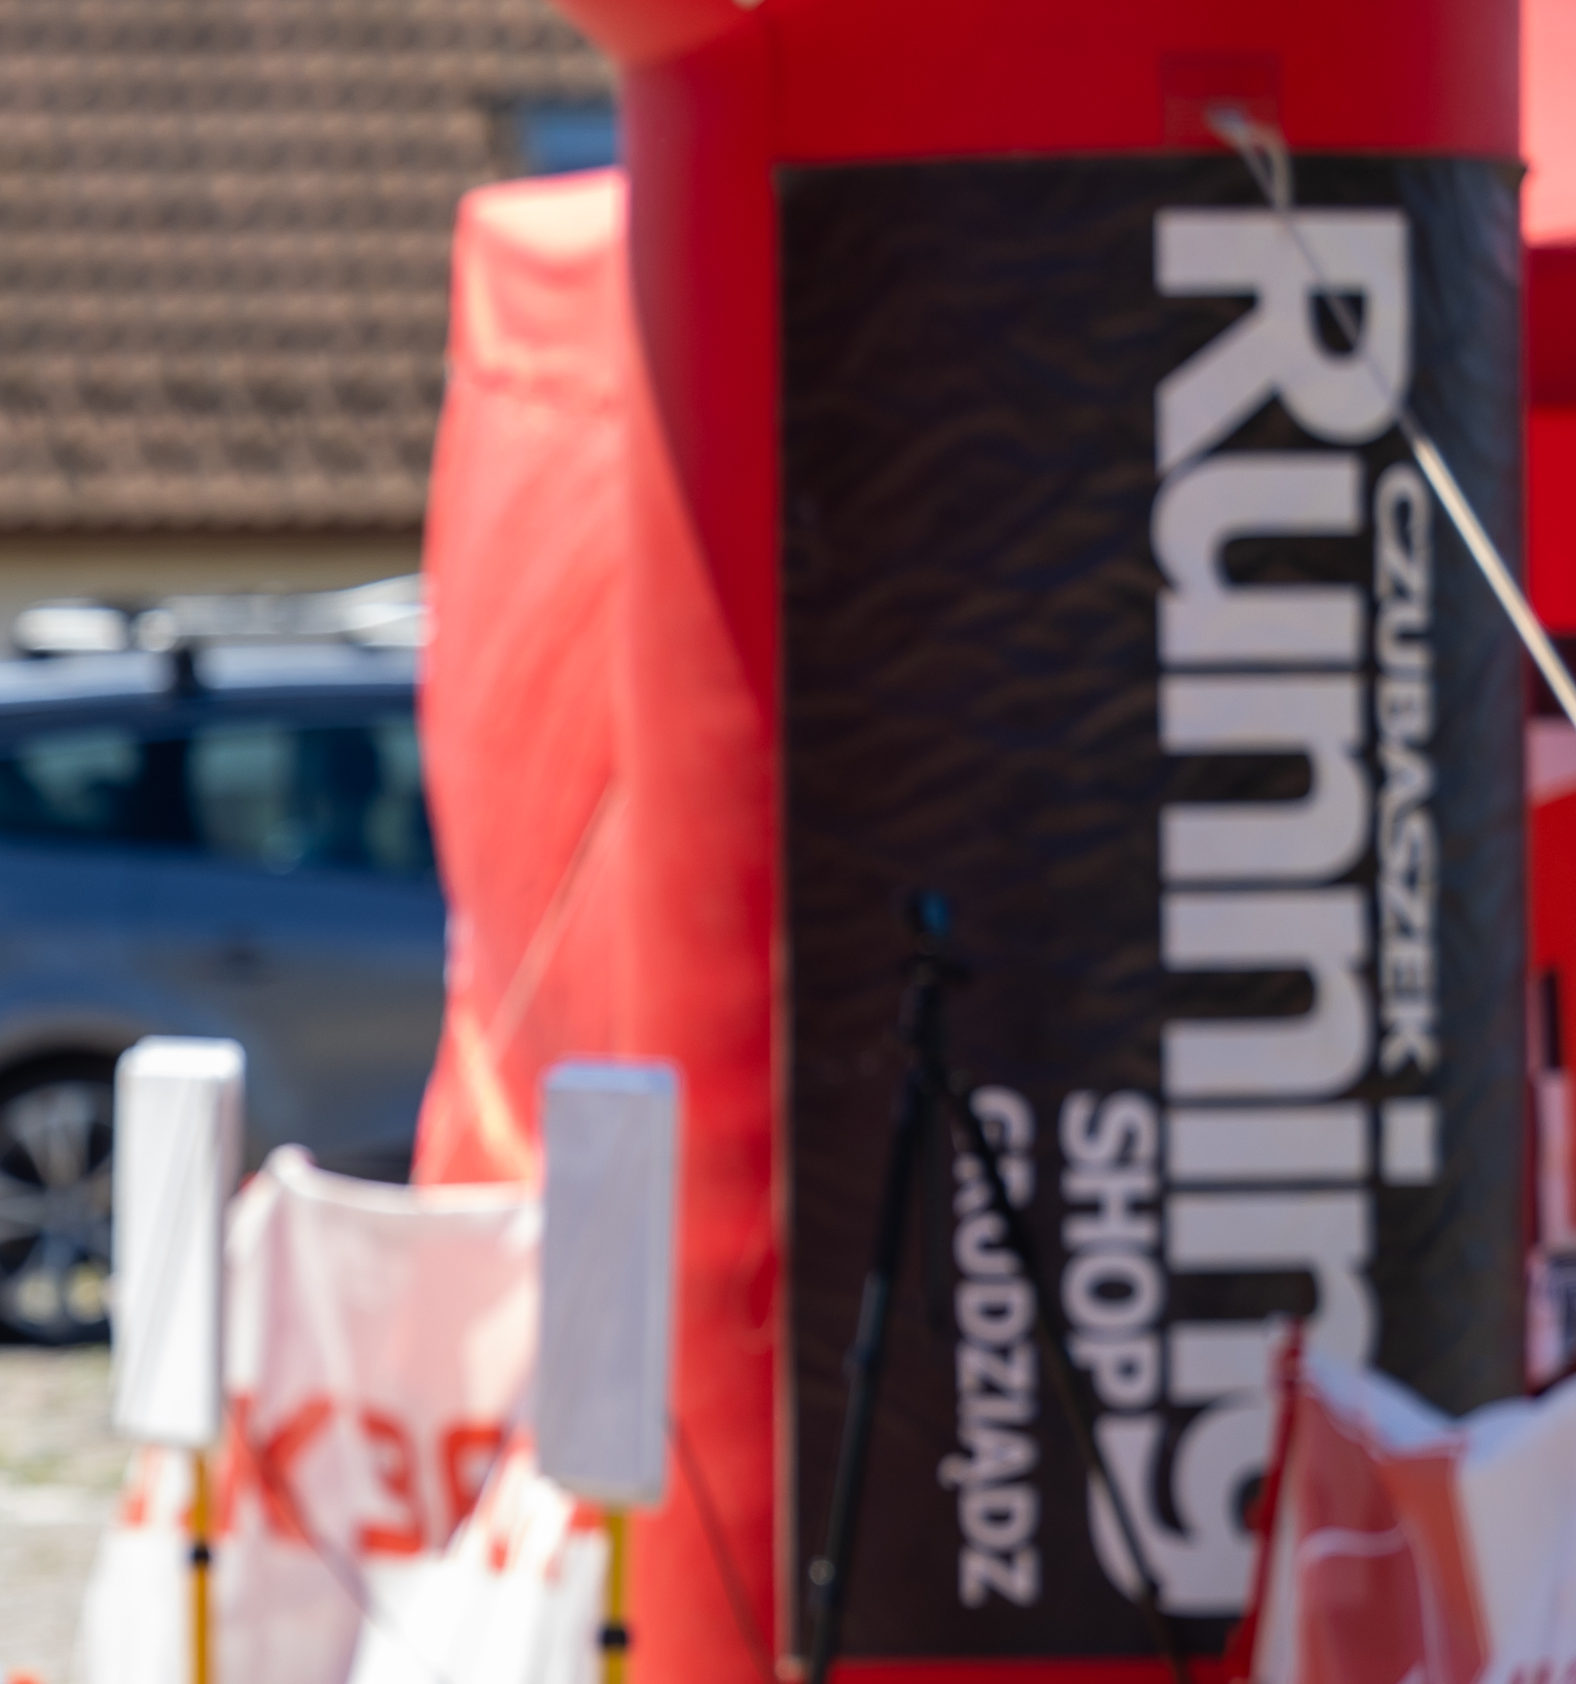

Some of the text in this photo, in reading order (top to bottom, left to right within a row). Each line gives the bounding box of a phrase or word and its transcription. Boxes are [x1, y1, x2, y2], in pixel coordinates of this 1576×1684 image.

[1085, 209, 1441, 1617] Running
[1373, 462, 1441, 1078] CZUBASZEK
[1059, 1088, 1165, 1413] SHOP
